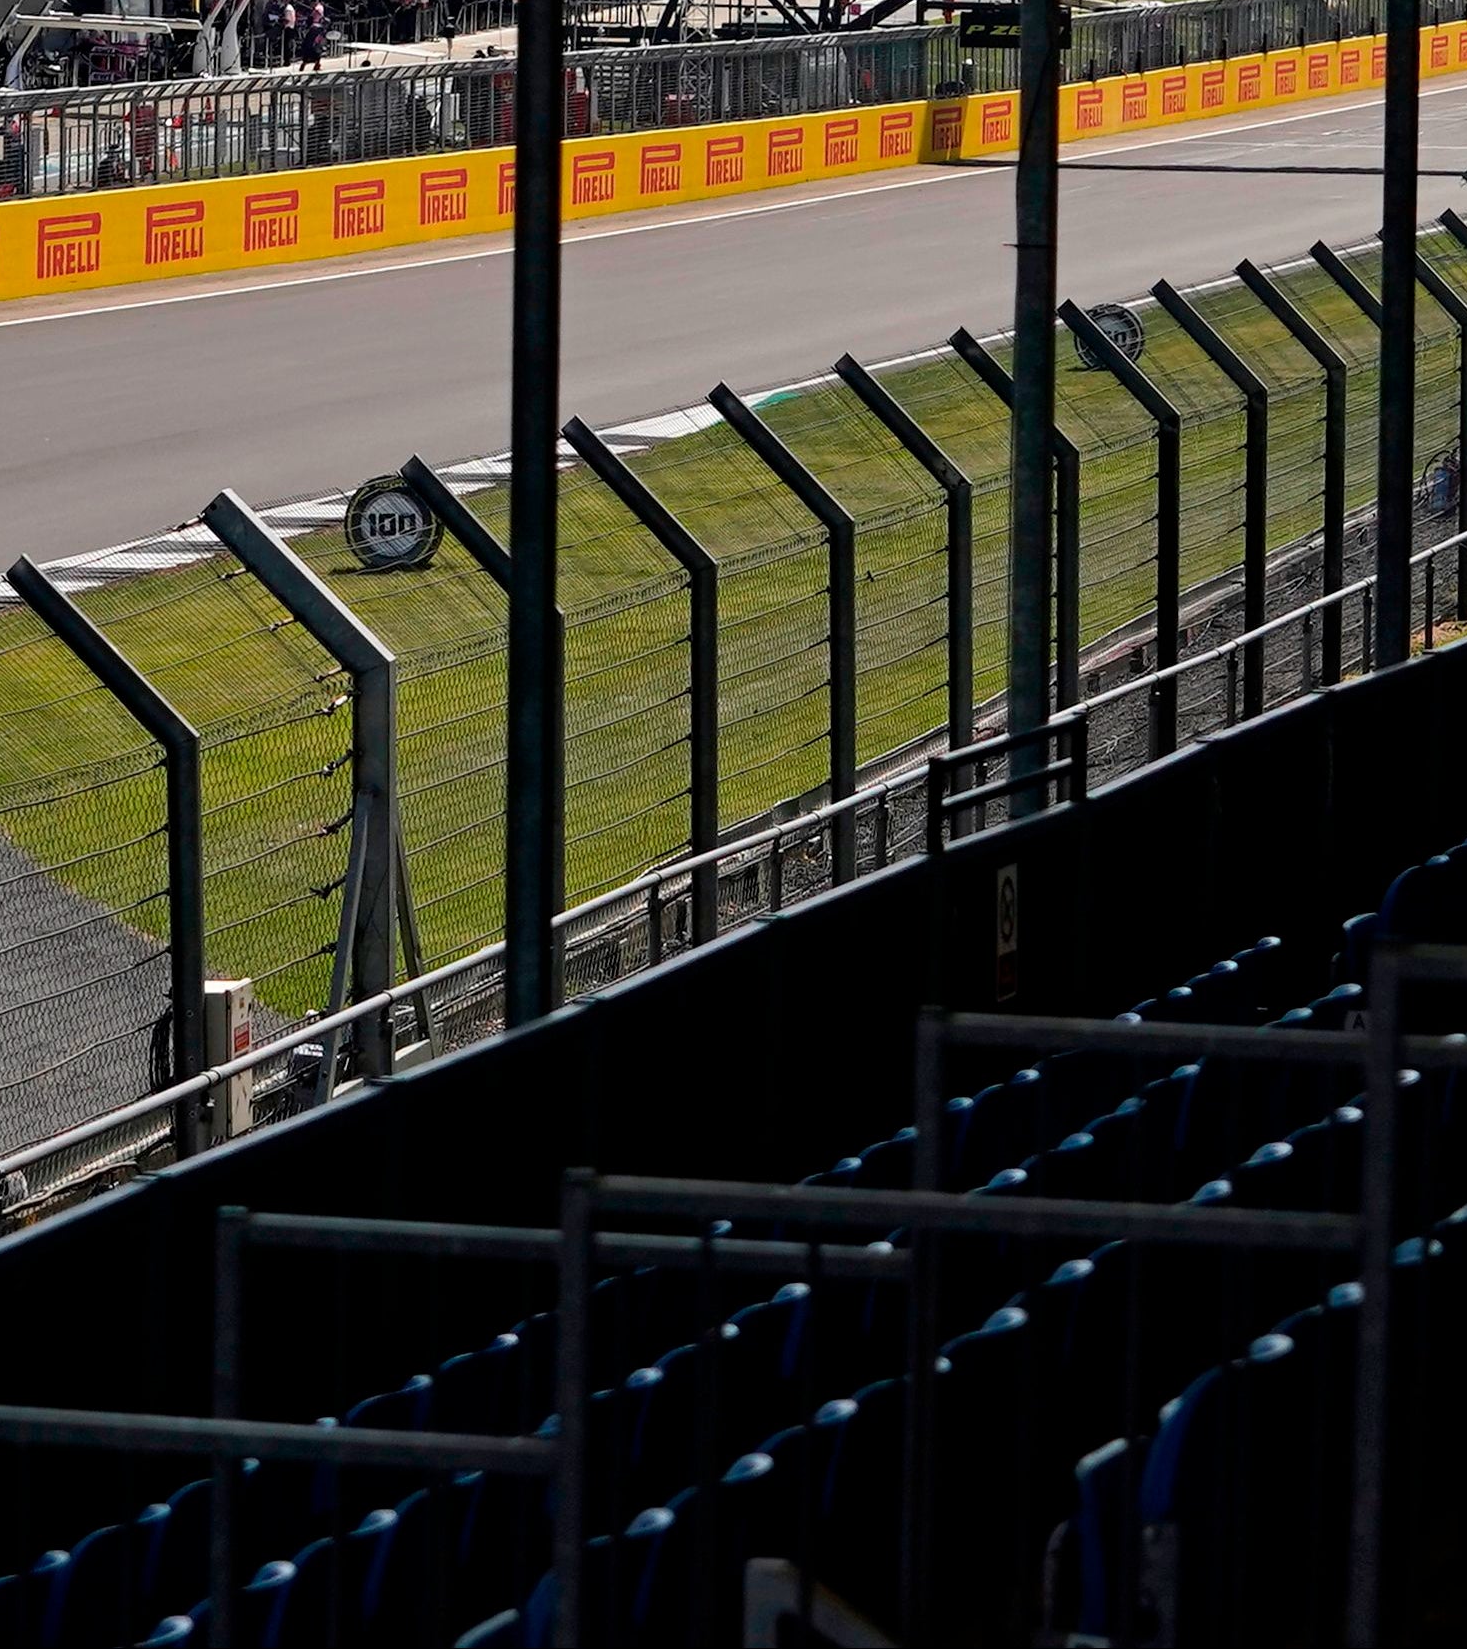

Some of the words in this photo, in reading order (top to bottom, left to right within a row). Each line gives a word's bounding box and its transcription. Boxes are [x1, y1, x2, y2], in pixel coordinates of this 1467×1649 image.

[935, 106, 963, 150] PIRELLI
[982, 100, 1012, 145] PIRELLI
[1077, 88, 1103, 130] PIRELLI
[767, 127, 804, 176] PIRELLI
[824, 119, 859, 167] PIRELLI
[880, 112, 913, 159] PIRELLI
[572, 151, 615, 205] PIRELLI
[640, 143, 682, 195] PIRELLI
[706, 136, 744, 186] PIRELLI
[243, 189, 299, 253] PIRELLI
[333, 179, 385, 239] PIRELLI
[420, 168, 468, 226] PIRELLI
[37, 212, 102, 280] PIRELLI
[145, 200, 205, 266] PIRELLI
[368, 513, 416, 537] 100
[1352, 1012, 1366, 1030] A
